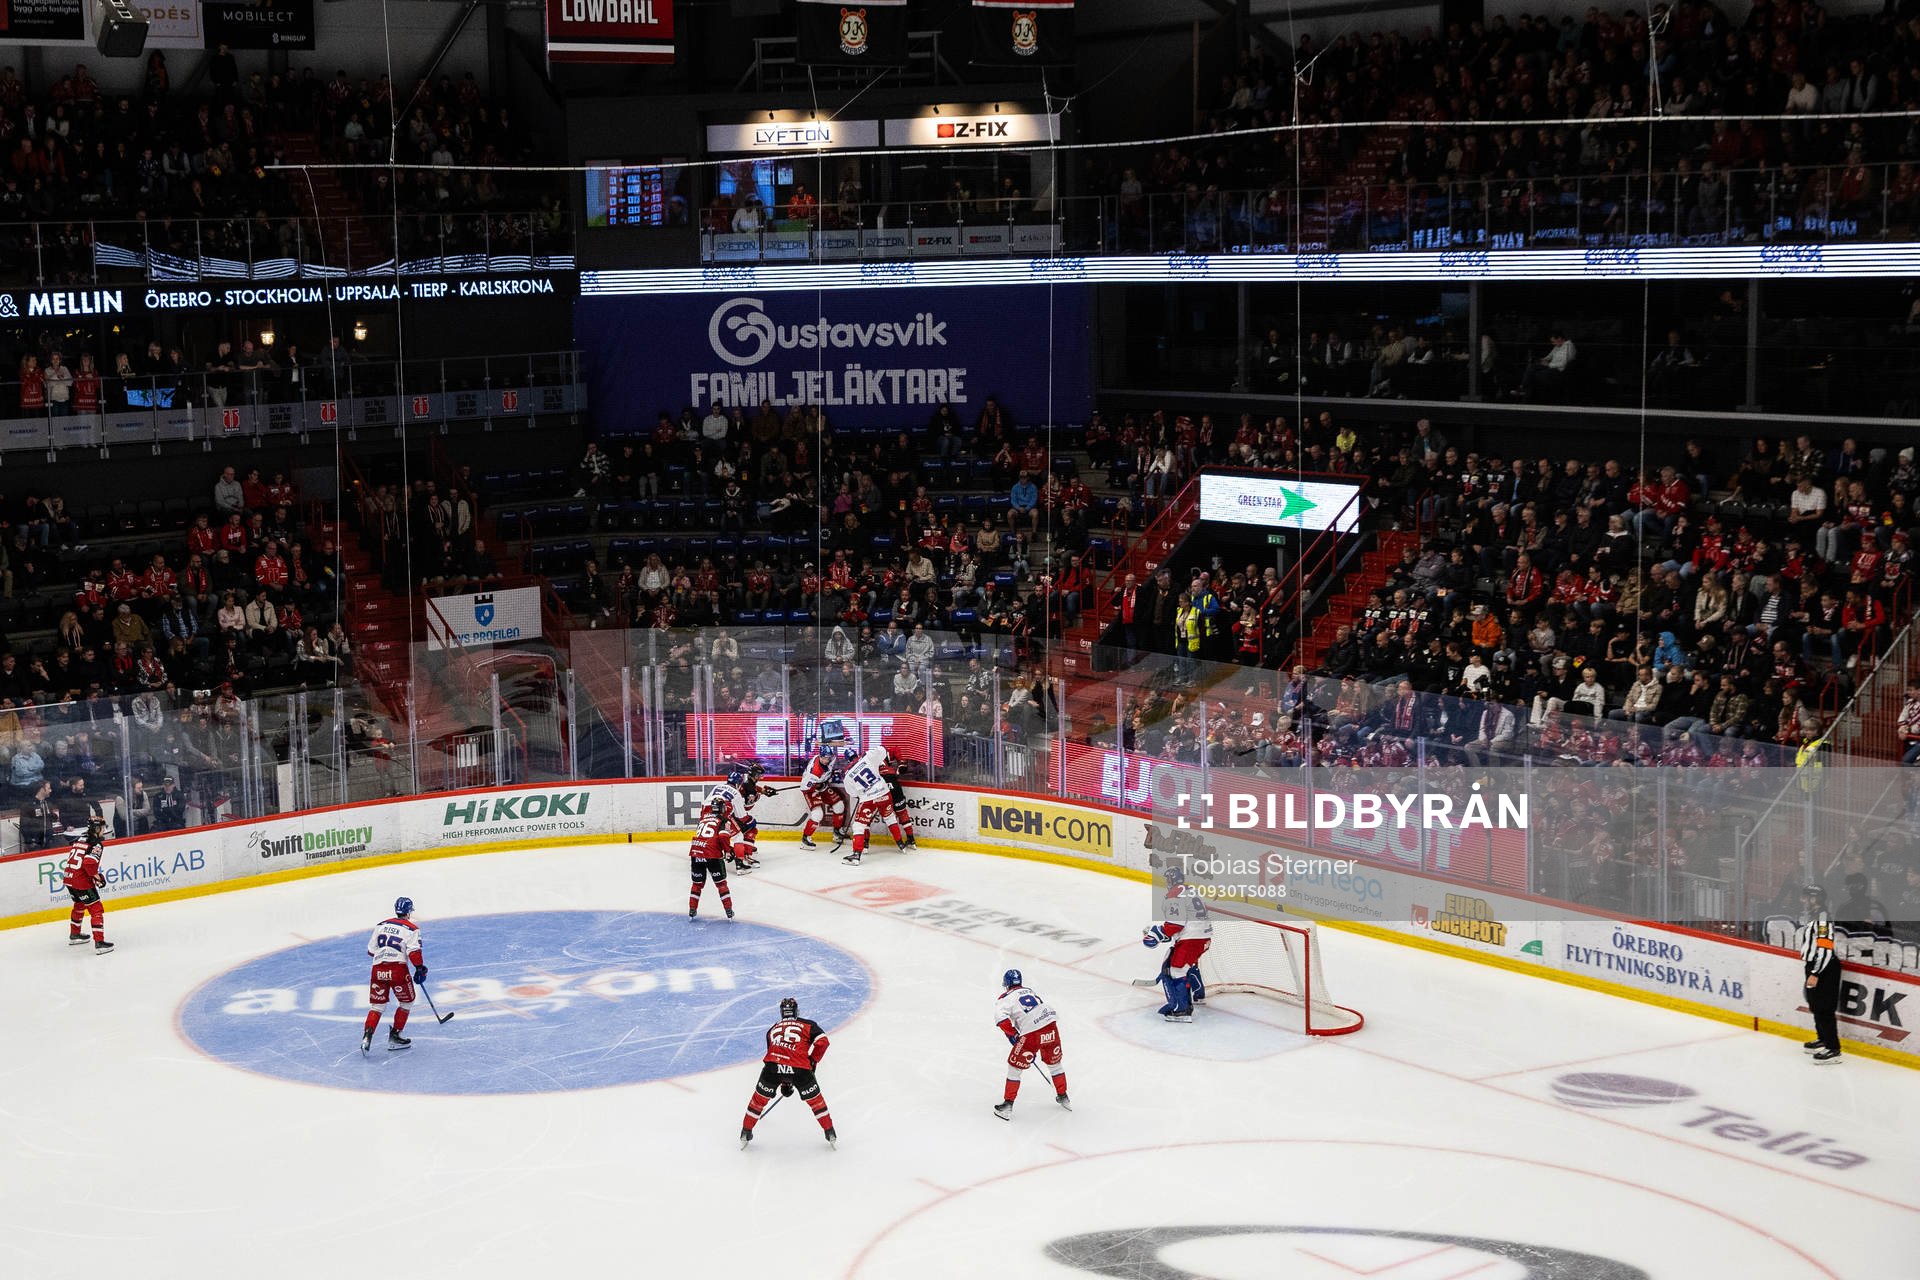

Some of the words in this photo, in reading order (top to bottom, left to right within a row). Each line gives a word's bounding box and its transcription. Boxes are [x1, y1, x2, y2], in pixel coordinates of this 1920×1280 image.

[14, 5, 33, 14] bygg
[35, 5, 47, 13] och
[49, 5, 80, 14] fastighet
[223, 10, 295, 23] MOBILECT
[756, 129, 830, 144] LYFTON
[956, 121, 1009, 138] Z-FIX
[928, 236, 952, 246] Z-FIX
[28, 290, 123, 317] MELLIN
[145, 289, 212, 309] ÖREBRO
[224, 286, 323, 306] STOCKHOLM
[335, 284, 401, 302] UPPSALA
[411, 282, 448, 299] TIERP
[459, 279, 554, 296] KARLSKRONA
[690, 363, 968, 408] FAMILJELÄKTARE
[1238, 494, 1262, 507] GREEN
[1263, 496, 1282, 509] STAR
[854, 767, 877, 788] 13
[442, 831, 463, 839] HIGH
[465, 825, 525, 837] PERFORMANCE
[527, 822, 557, 832] POWER
[558, 821, 585, 830] TOOLS
[938, 816, 955, 830] AB
[172, 850, 206, 873] AB
[305, 849, 336, 861] Transport
[342, 844, 366, 855] Logistik
[1445, 893, 1488, 921] EURO
[891, 907, 985, 933] SPEL
[926, 900, 1103, 947] SVENSKA
[1431, 911, 1506, 947] JACKPOT
[1611, 926, 1684, 962] ÖREBRO
[377, 969, 392, 979] port
[1566, 943, 1714, 993] FLYTTNINGSBYRÅ
[1718, 978, 1745, 1000] AB
[1040, 1030, 1056, 1043] port
[777, 1064, 795, 1074] NA
[1680, 1105, 1870, 1170] Telia
